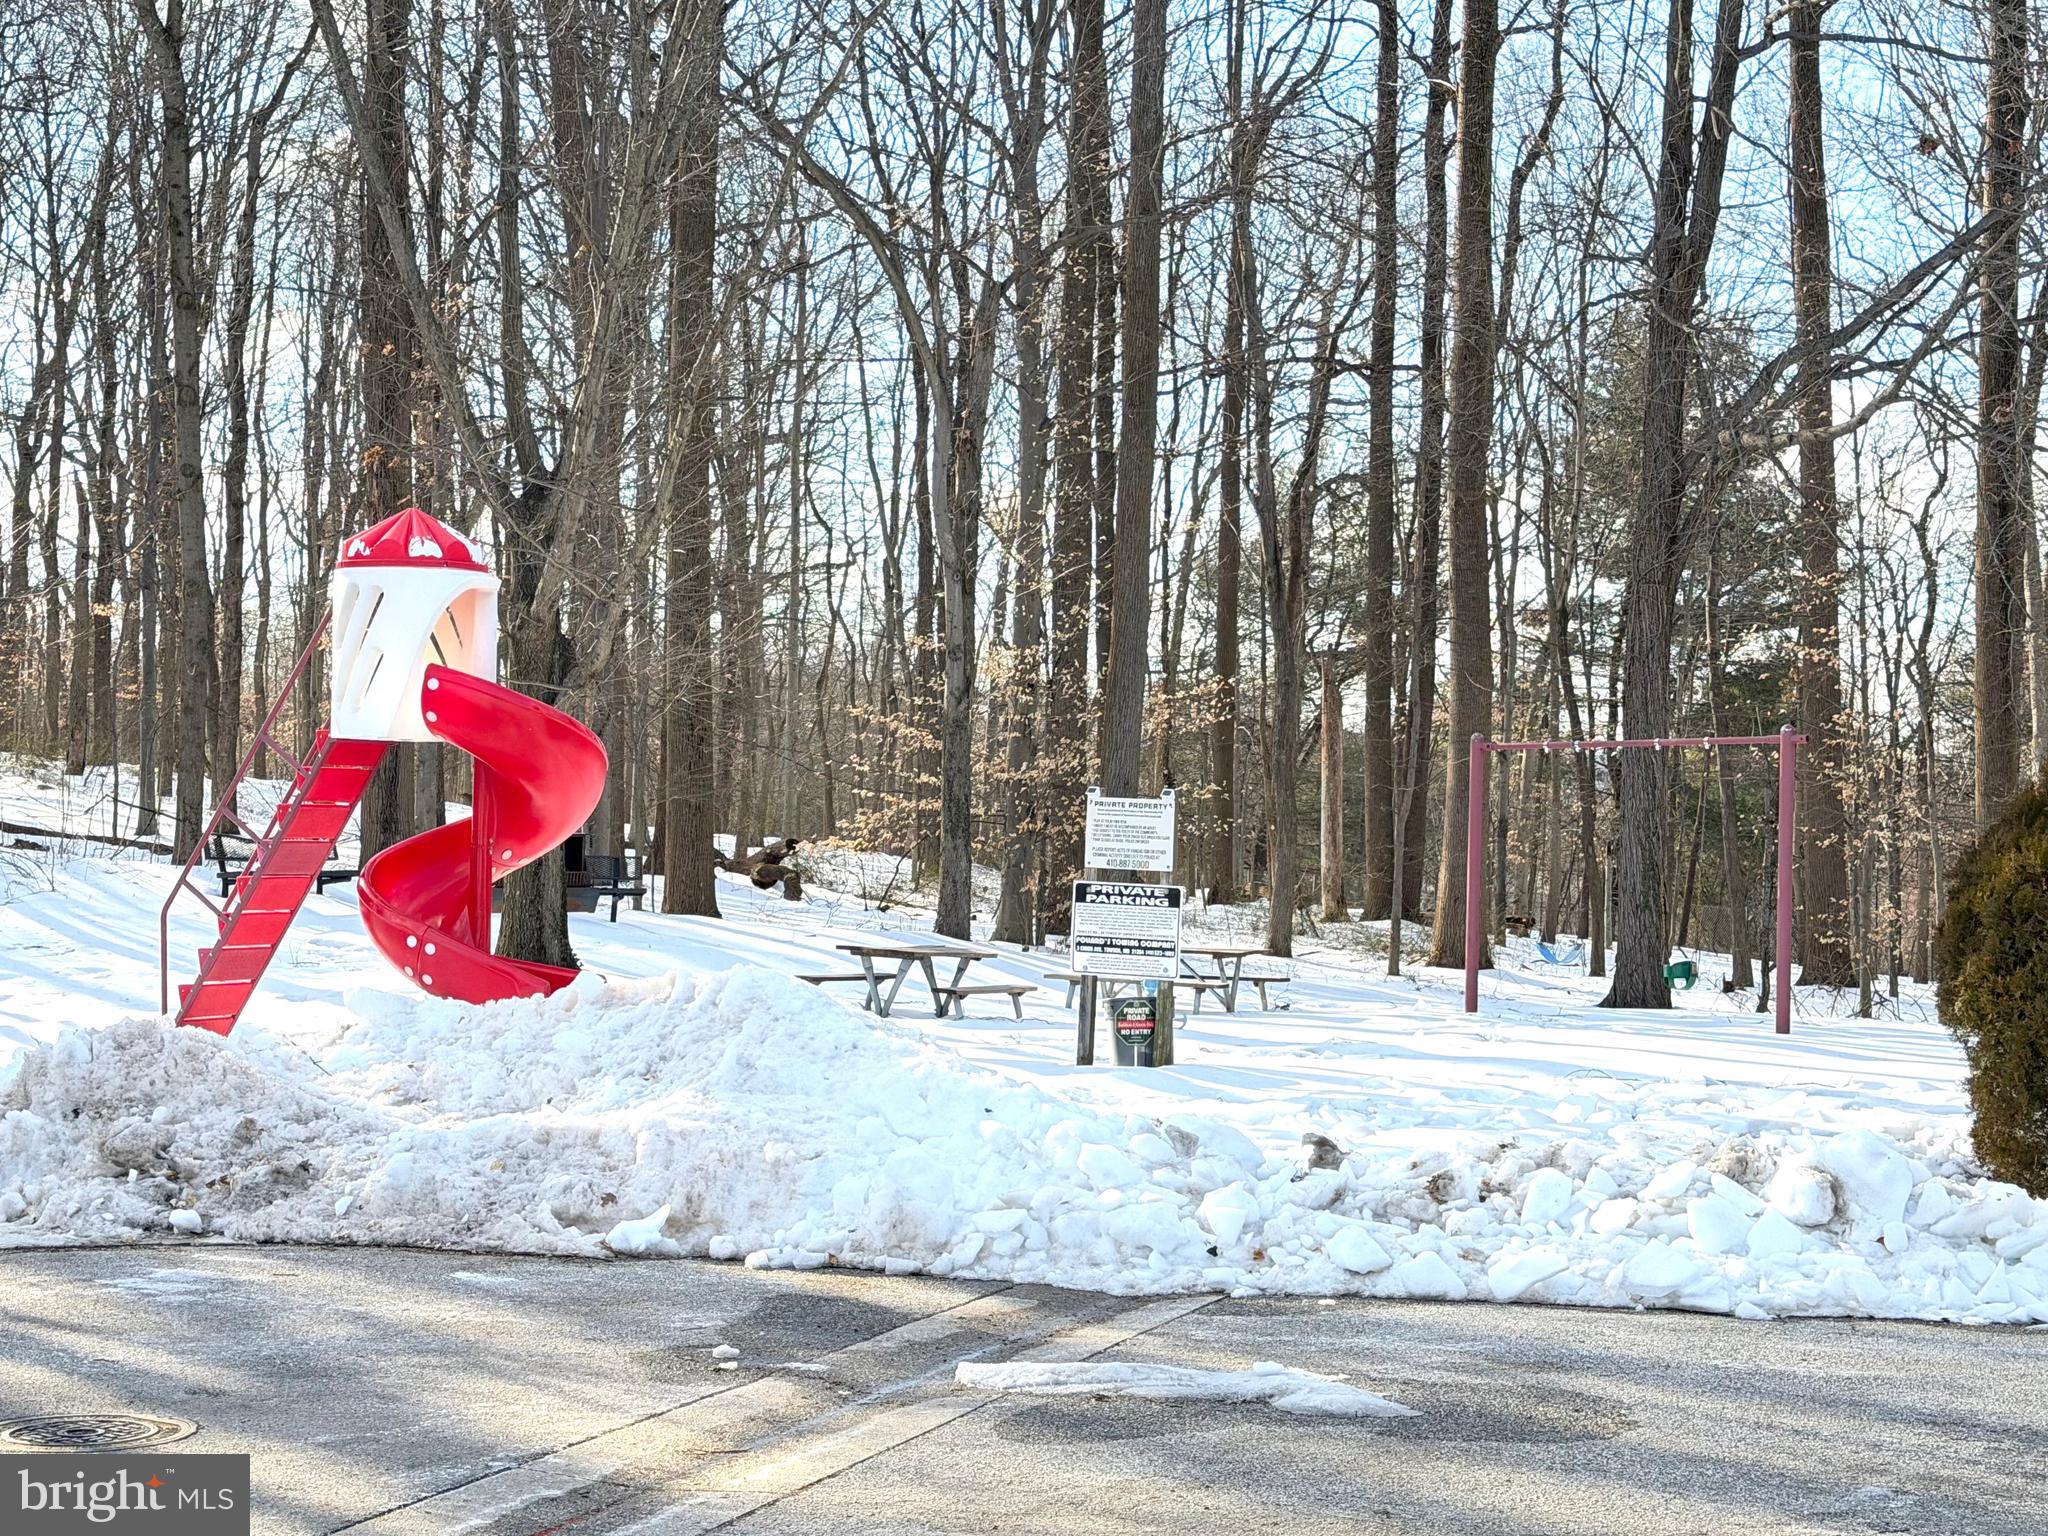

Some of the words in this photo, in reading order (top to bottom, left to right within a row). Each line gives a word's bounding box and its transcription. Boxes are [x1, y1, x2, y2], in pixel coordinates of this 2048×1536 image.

[1128, 802, 1168, 810] PROPERTY
[1090, 884, 1165, 897] PRIVATE
[1085, 894, 1169, 907] PARKING
[1076, 936, 1111, 945] POLLARD'S
[1112, 938, 1139, 947] TOWING
[1140, 940, 1175, 949] COMPANY
